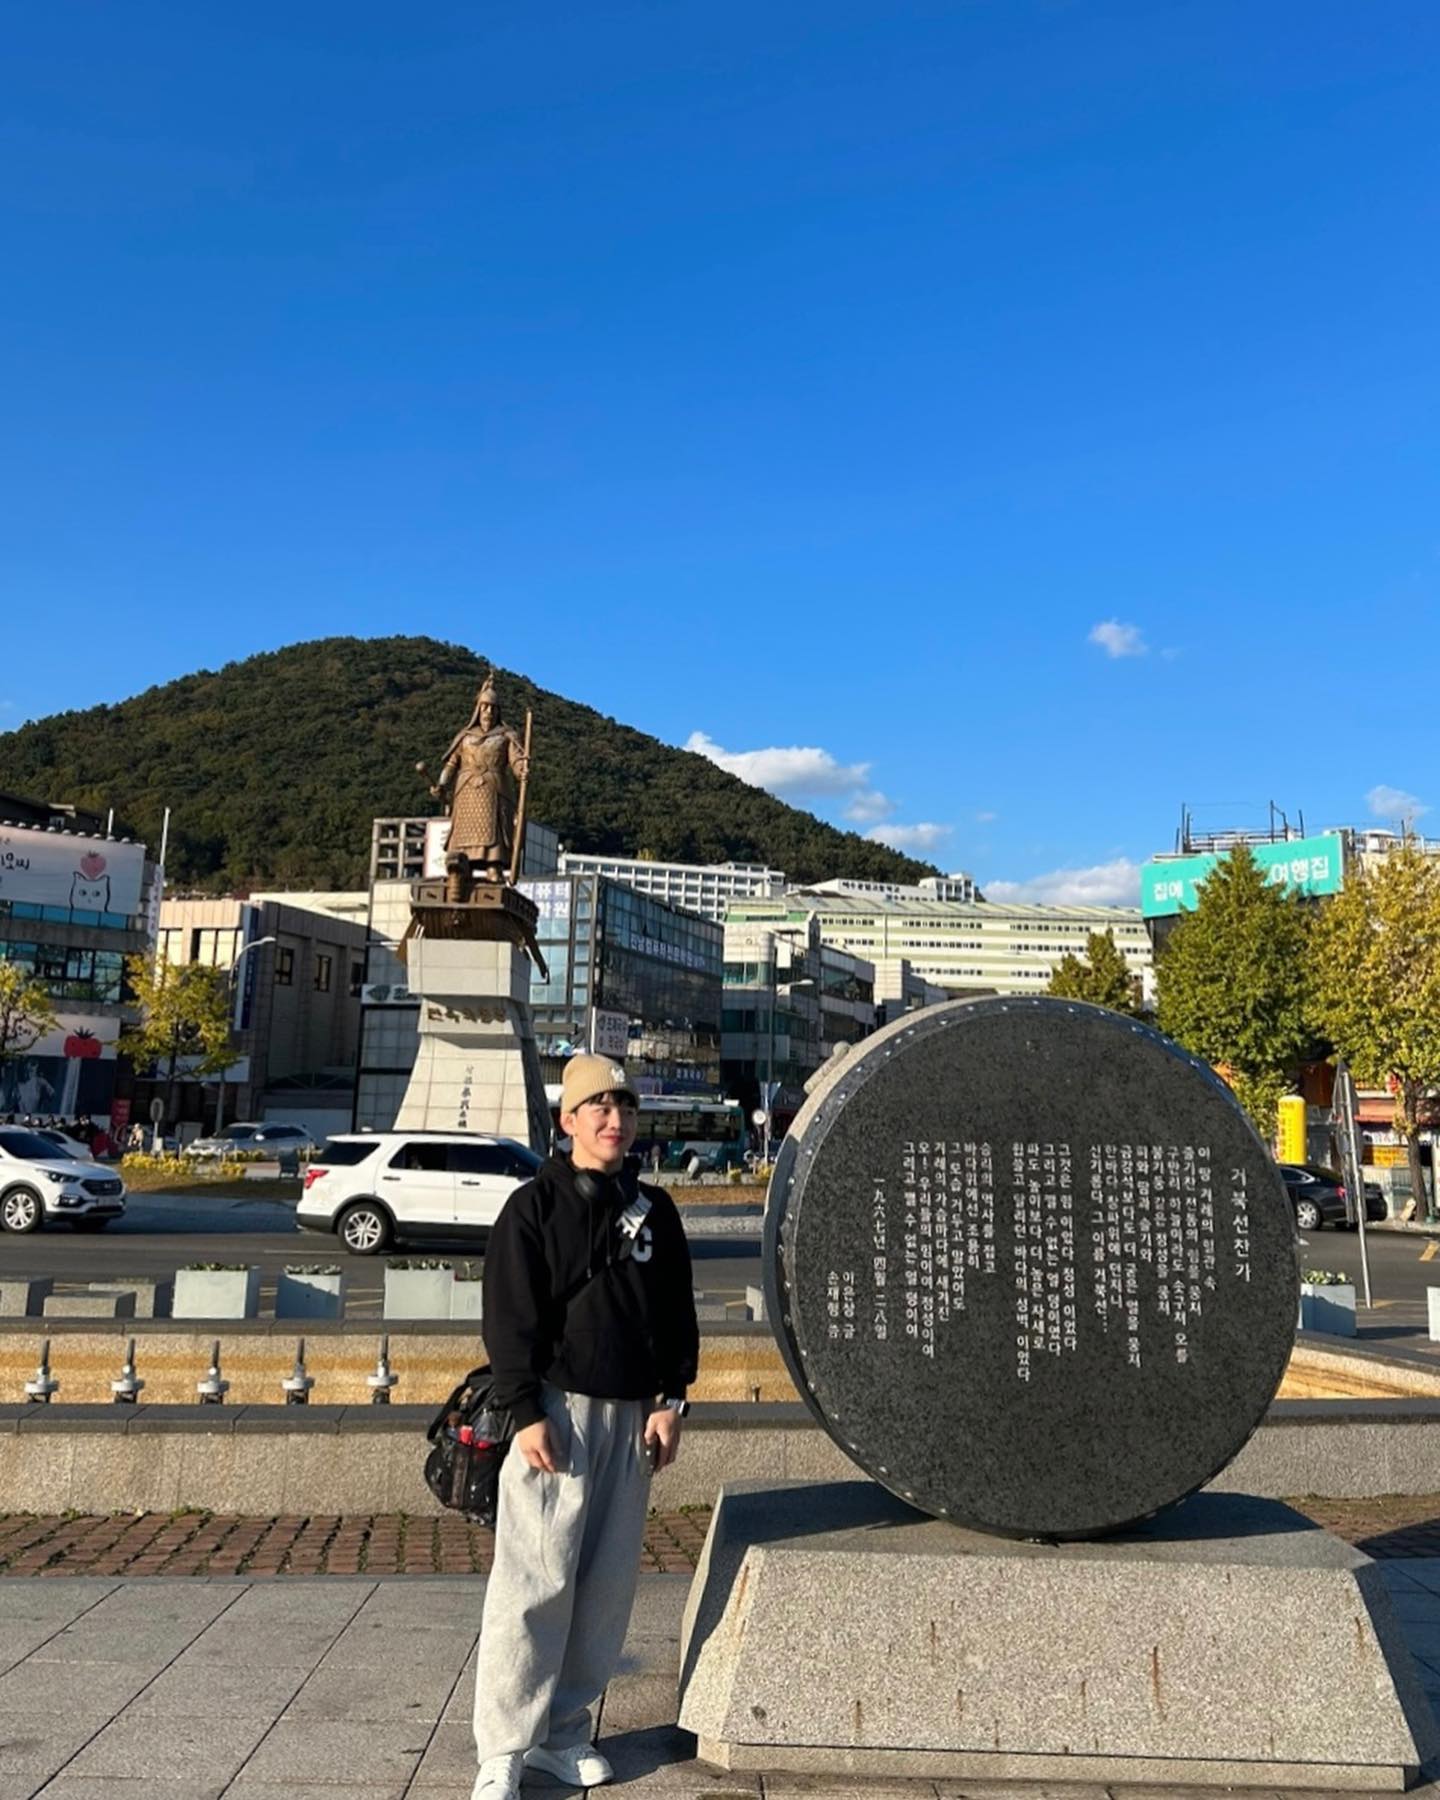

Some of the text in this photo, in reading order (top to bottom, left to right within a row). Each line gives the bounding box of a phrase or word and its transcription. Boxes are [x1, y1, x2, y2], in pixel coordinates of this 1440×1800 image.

[1153, 880, 1184, 901] 집에
[1271, 856, 1329, 883] 여행집
[903, 1142, 916, 1184] 그리고
[934, 1142, 946, 1186] 겨레의
[1043, 1144, 1056, 1187] 그리고
[1089, 1145, 1103, 1204] 신기롭다
[1104, 1145, 1117, 1189] 한바다
[1167, 1146, 1180, 1190] 구만리
[1198, 1147, 1210, 1160] 이
[1199, 1167, 1211, 1182] 땅
[919, 1177, 931, 1237] 우리들의
[980, 1142, 997, 1273] 승리의 역사를 접고
[1120, 1145, 1135, 1233] 금강석보다도
[1136, 1145, 1152, 1262] 피와 땀과 슬기와
[1200, 1188, 1213, 1233] 겨레의
[873, 1178, 886, 1250] 一九六七년
[904, 1213, 917, 1227] 수
[935, 1193, 948, 1268] 가슴마다에
[950, 1142, 966, 1310] 그 모습 거두고 말았어도
[1045, 1215, 1057, 1230] 수
[1091, 1211, 1104, 1224] 그
[1151, 1145, 1170, 1315] 불기둥 같은 정성을 뭉쳐
[1169, 1197, 1185, 1271] 하늘이라도
[1182, 1145, 1202, 1316] 줄기찬 전통의 힘을 뭉쳐
[1231, 1168, 1251, 1282] 거북선찬가
[905, 1234, 917, 1264] 없는
[920, 1244, 933, 1289] 힘이여
[967, 1224, 980, 1269] 조용히
[1012, 1143, 1031, 1382] 휩쓸고 달리던 바다의 성벽 이었다
[1028, 1143, 1045, 1349] 파도 높이보다 더 높은 자세로
[1046, 1237, 1059, 1266] 없는
[1059, 1144, 1077, 1350] 그것은 힘 이었다 정성 이었다
[1092, 1232, 1105, 1262] 이름
[1124, 1242, 1136, 1256] 더
[827, 1271, 839, 1317] 손재형
[905, 1271, 917, 1286] 얼
[1047, 1272, 1059, 1288] 얼
[1109, 1262, 1123, 1308] 던지니
[842, 1271, 855, 1339] 이은상 글
[874, 1294, 887, 1340] 二八일
[906, 1292, 918, 1338] 덩이여
[1127, 1300, 1139, 1331] 얼을
[1172, 1280, 1186, 1326] 솟구쳐
[922, 1297, 934, 1358] 정성이여
[1128, 1337, 1141, 1368] 뭉쳐
